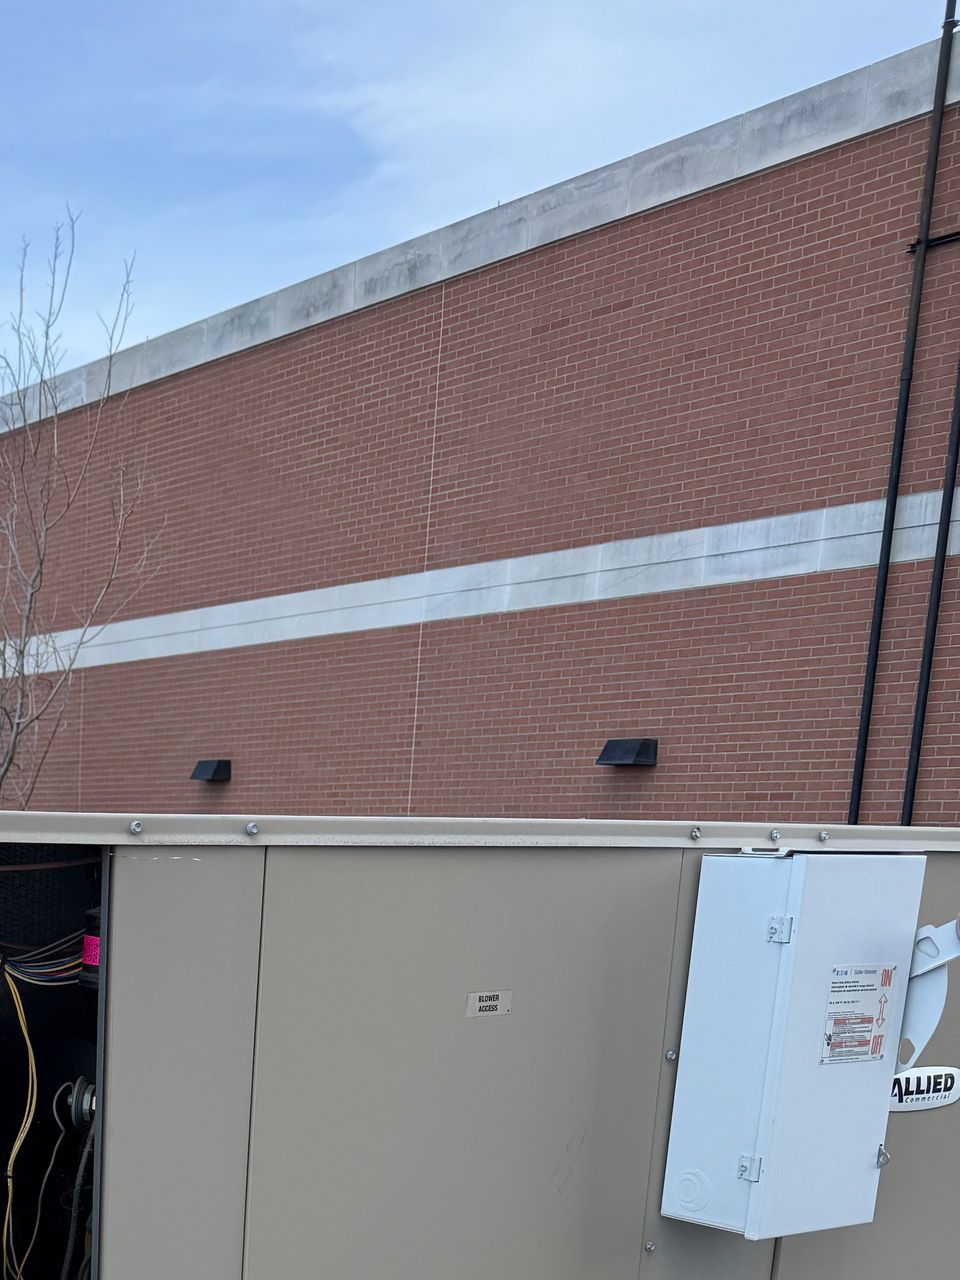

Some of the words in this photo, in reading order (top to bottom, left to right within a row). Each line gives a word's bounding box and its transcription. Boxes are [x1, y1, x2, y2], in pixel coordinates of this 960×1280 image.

[880, 968, 893, 987] ON
[478, 994, 500, 1003] BLOWER
[478, 1004, 499, 1013] ACCESS
[871, 1034, 884, 1055] OFF
[891, 1073, 955, 1103] ALLIED
[905, 1093, 951, 1103] Commercial
